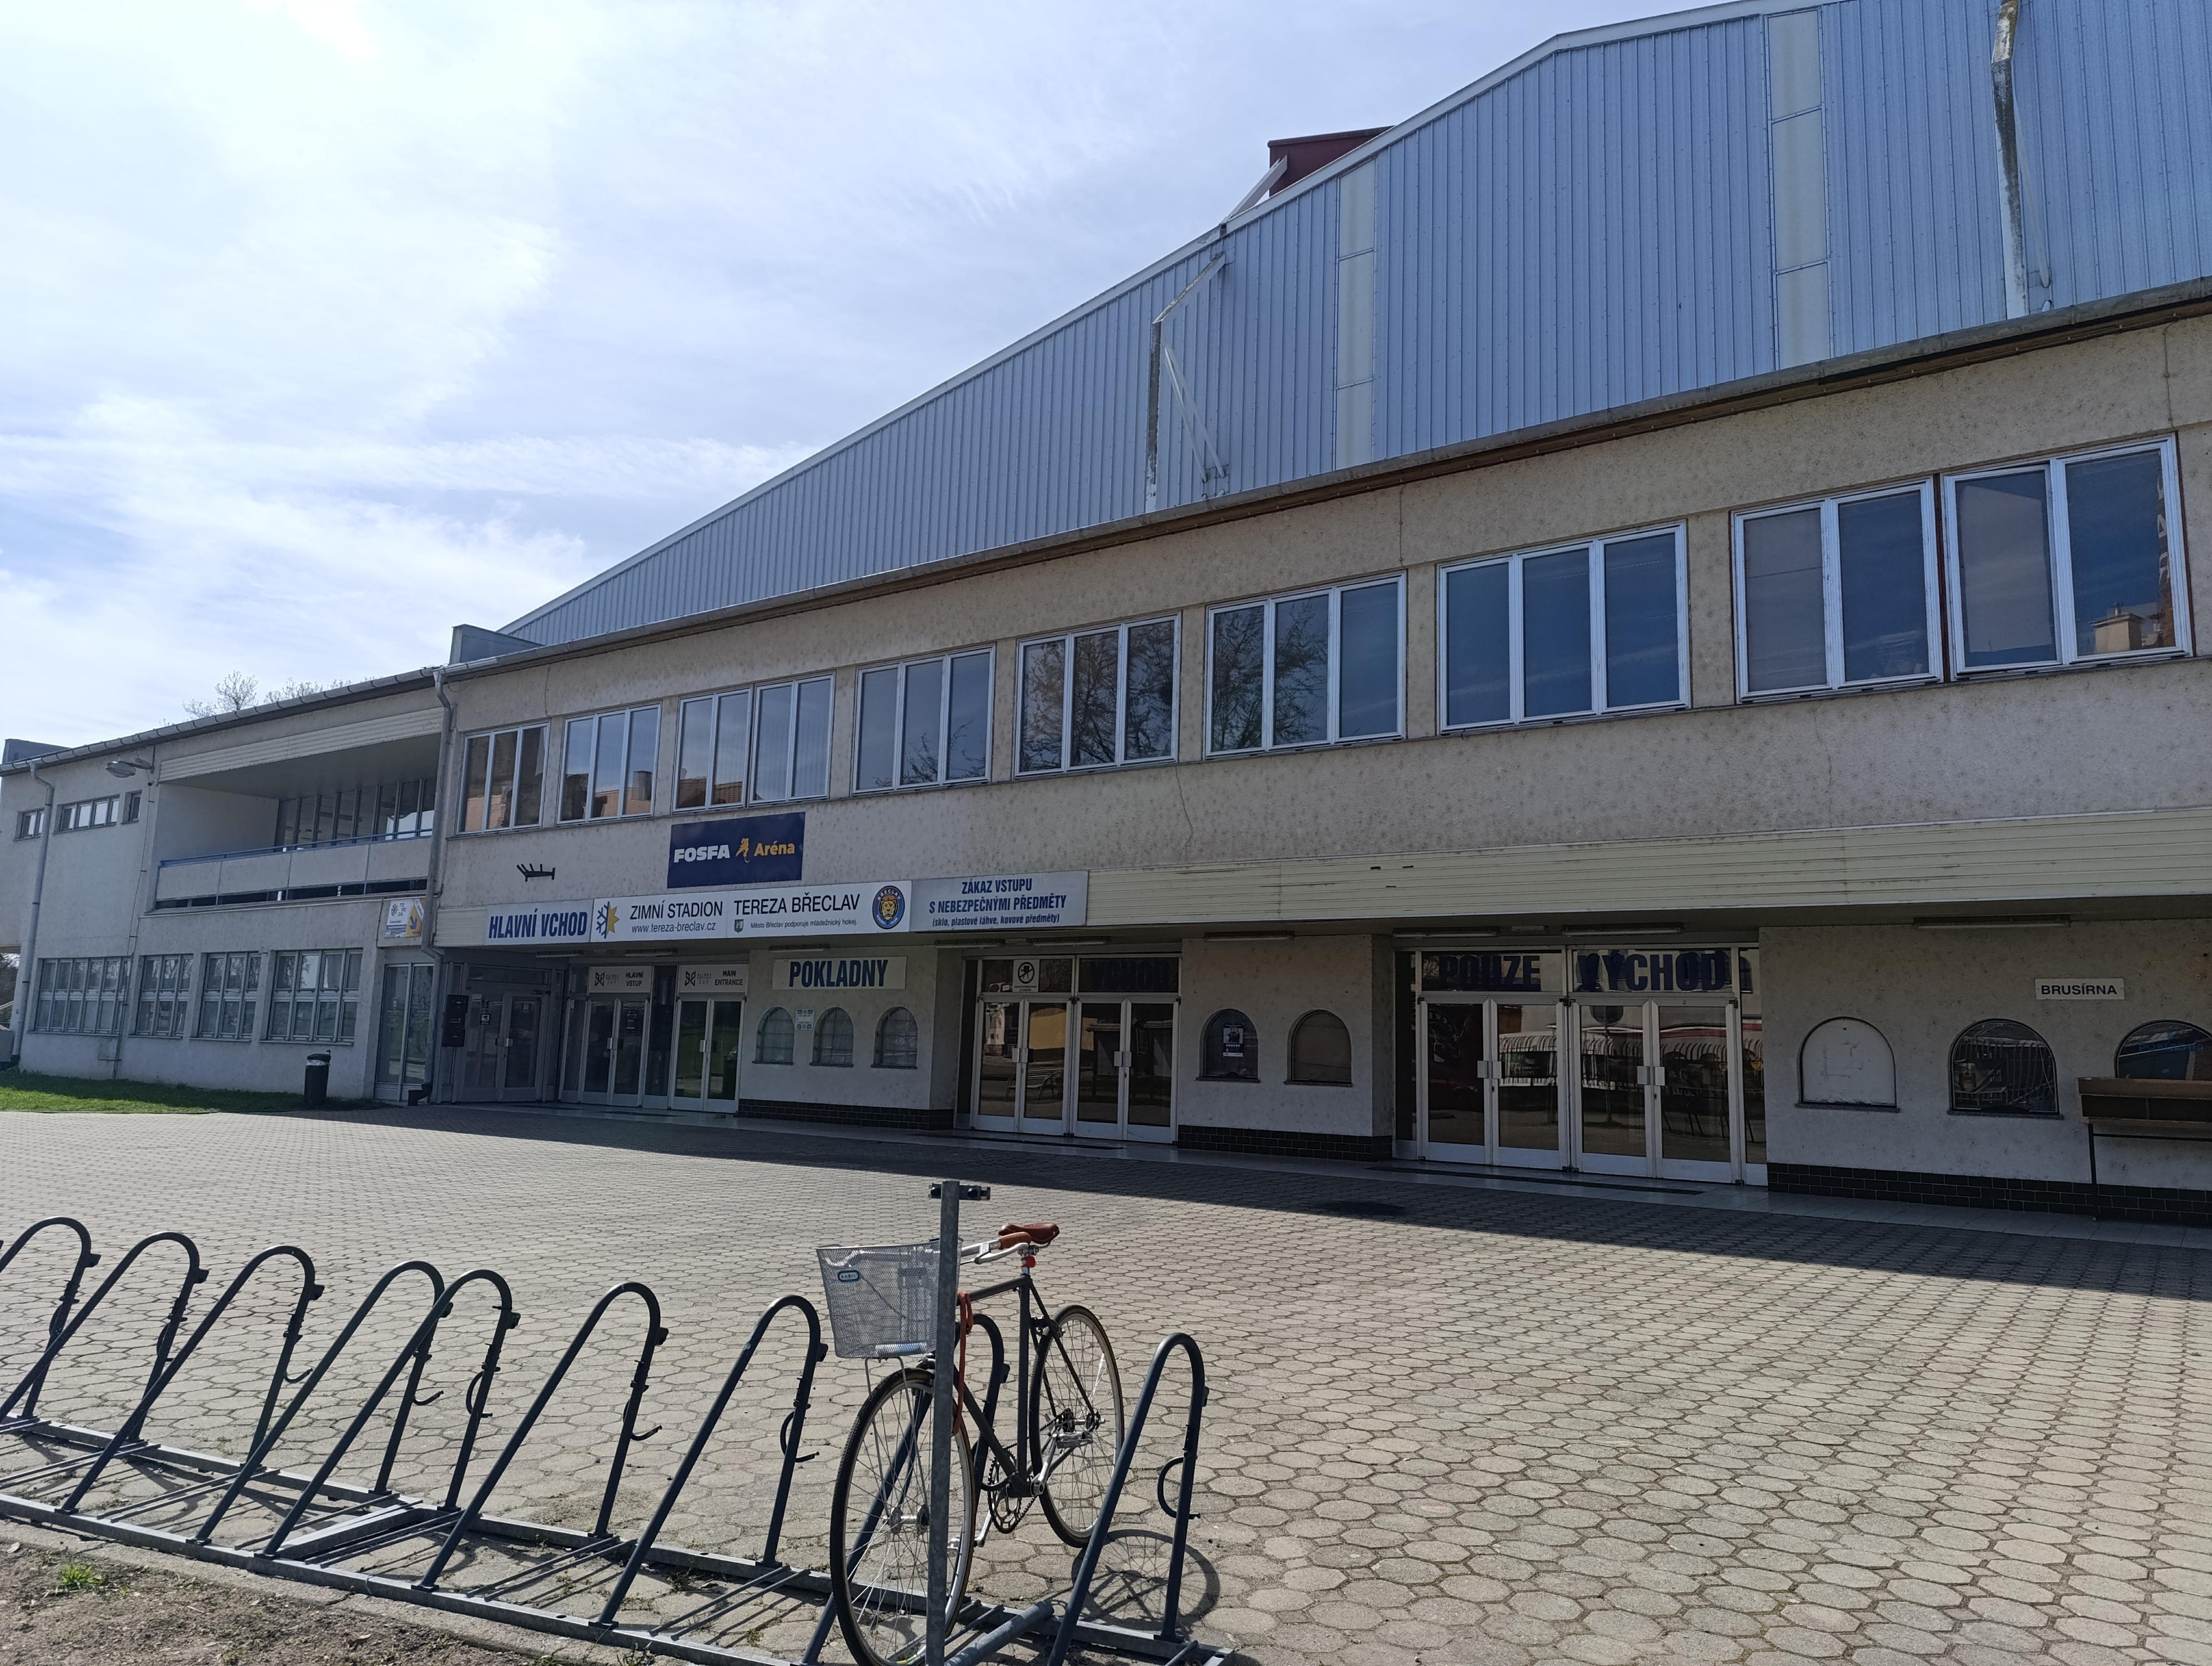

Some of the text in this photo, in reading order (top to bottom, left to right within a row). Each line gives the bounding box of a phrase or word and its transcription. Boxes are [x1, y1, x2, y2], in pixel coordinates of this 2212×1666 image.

[673, 840, 795, 863] FOSFA Aréna
[962, 878, 1033, 894] ZÁKAZ VSTUPU
[630, 900, 723, 920] ZIMNÍ STADION
[733, 892, 861, 915] TEREZA BŘECLAV
[929, 893, 1067, 914] S NEBEZPEČNÝMI PŘEDMĚTY
[489, 908, 587, 939] HLAVNÍ VCHOD
[632, 921, 716, 933] www.tereza-breclav.cz
[785, 920, 809, 929] podporuje
[932, 913, 1060, 927] (sklo, plastové láhve, kovové předměty)
[789, 959, 888, 987] POKLADNY
[1439, 955, 1541, 991] POUZE
[2041, 983, 2118, 995] BRUSÍRNA
